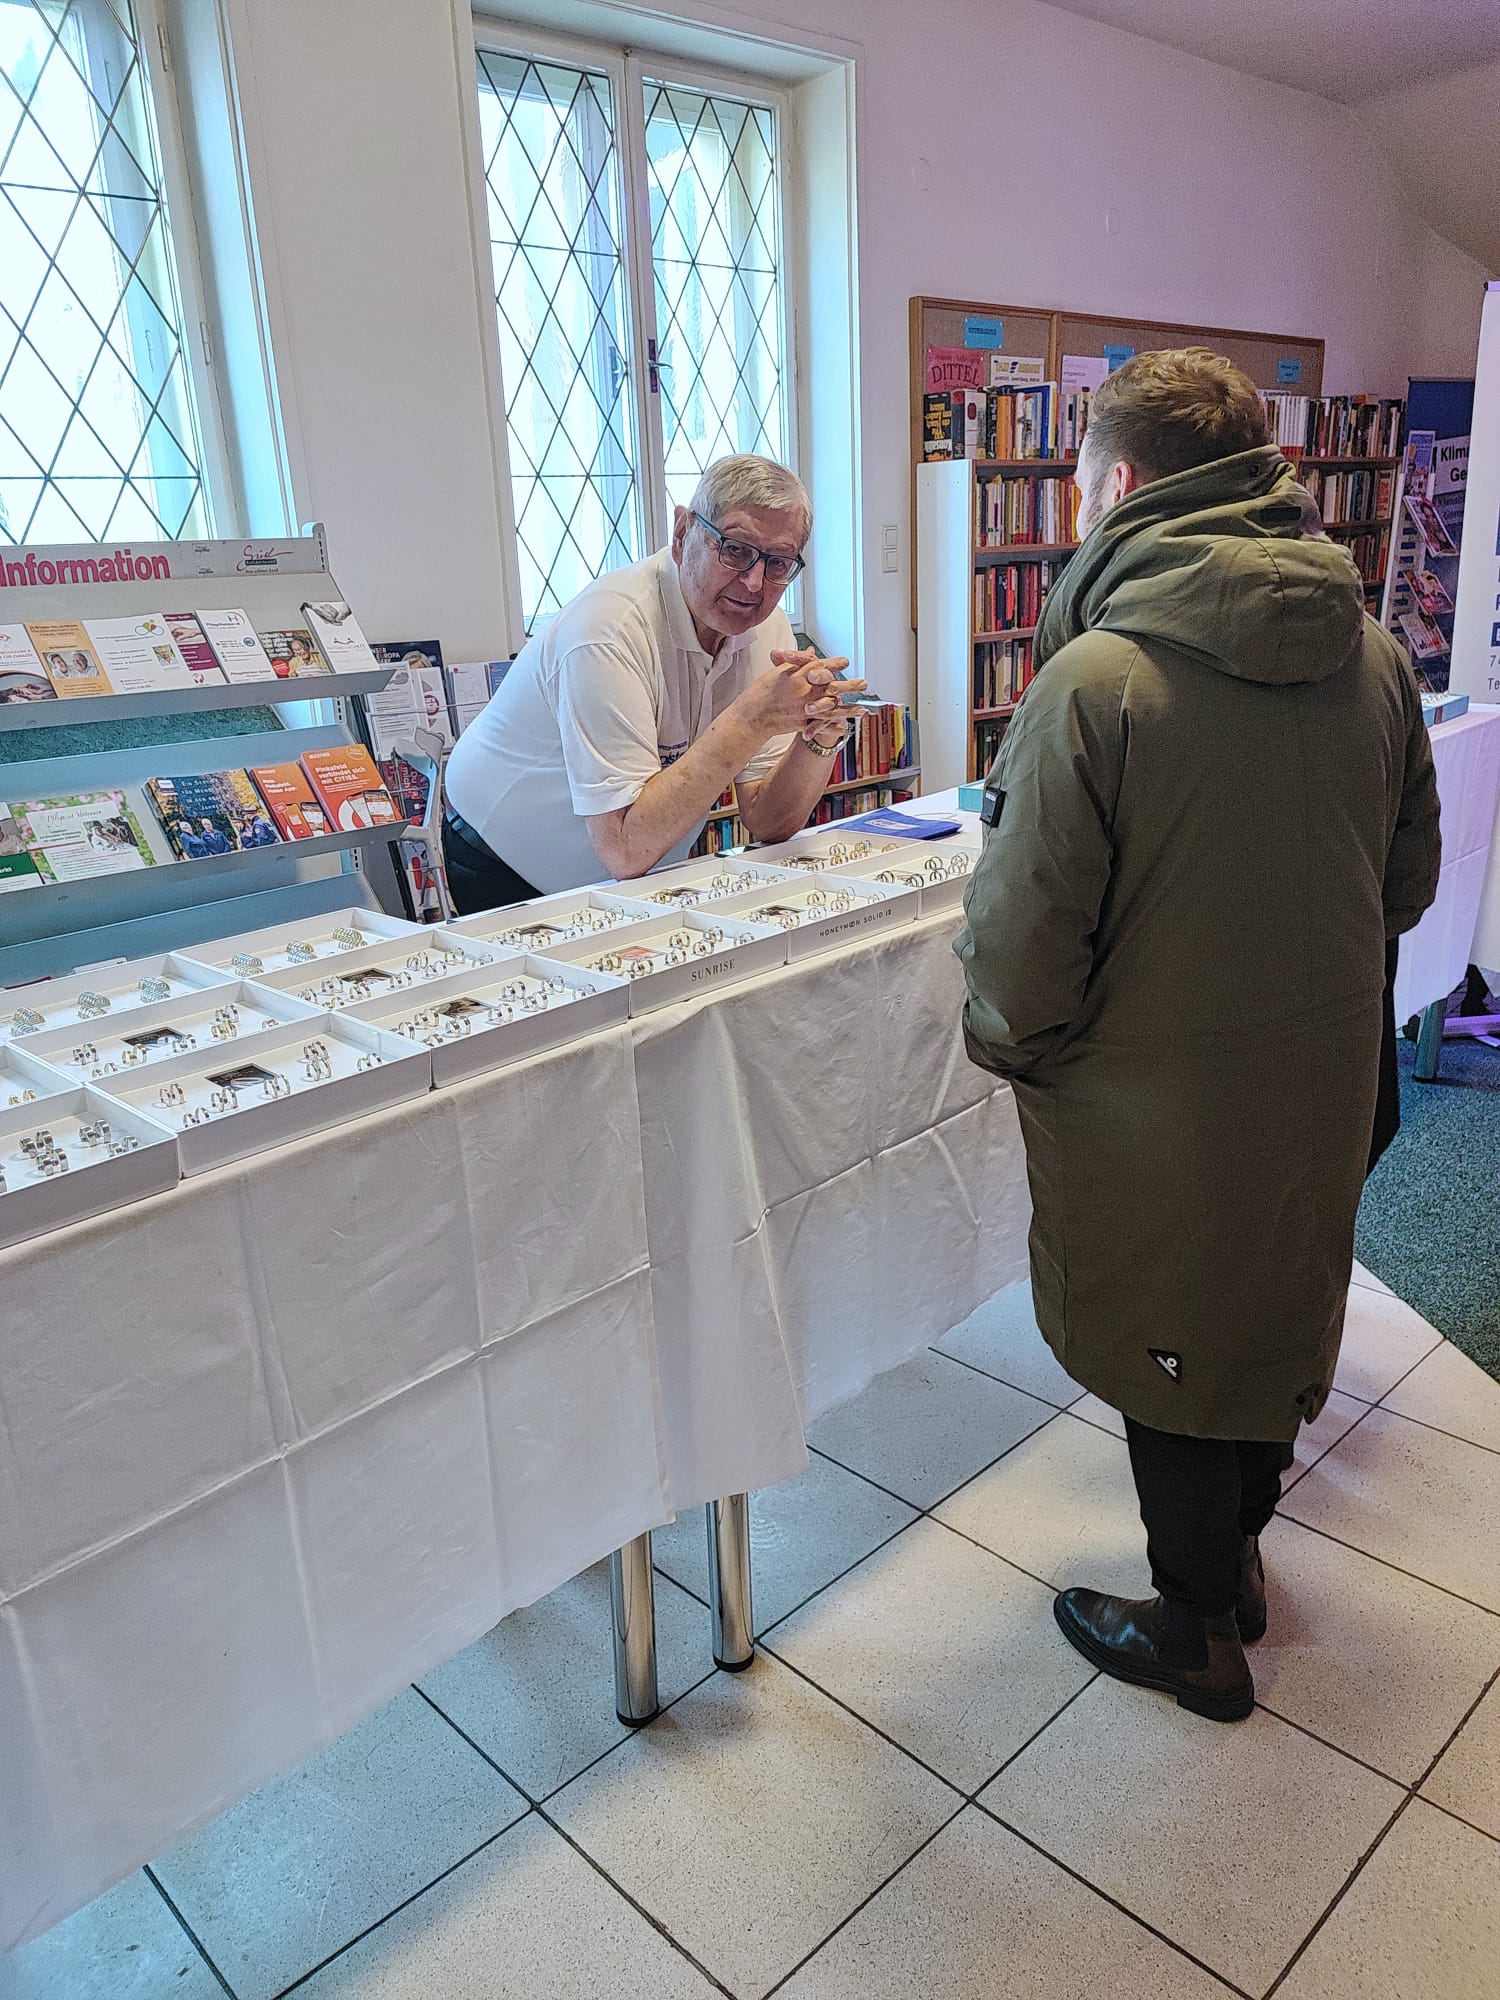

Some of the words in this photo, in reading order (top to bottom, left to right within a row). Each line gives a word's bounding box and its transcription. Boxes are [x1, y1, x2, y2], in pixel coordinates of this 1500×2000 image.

[931, 363, 979, 387] DITTEL
[0, 549, 171, 587] Information
[315, 763, 348, 773] Pinkafeld
[318, 769, 352, 780] verbindet
[863, 910, 884, 924] SOLID
[691, 959, 736, 982] SUNRISE
